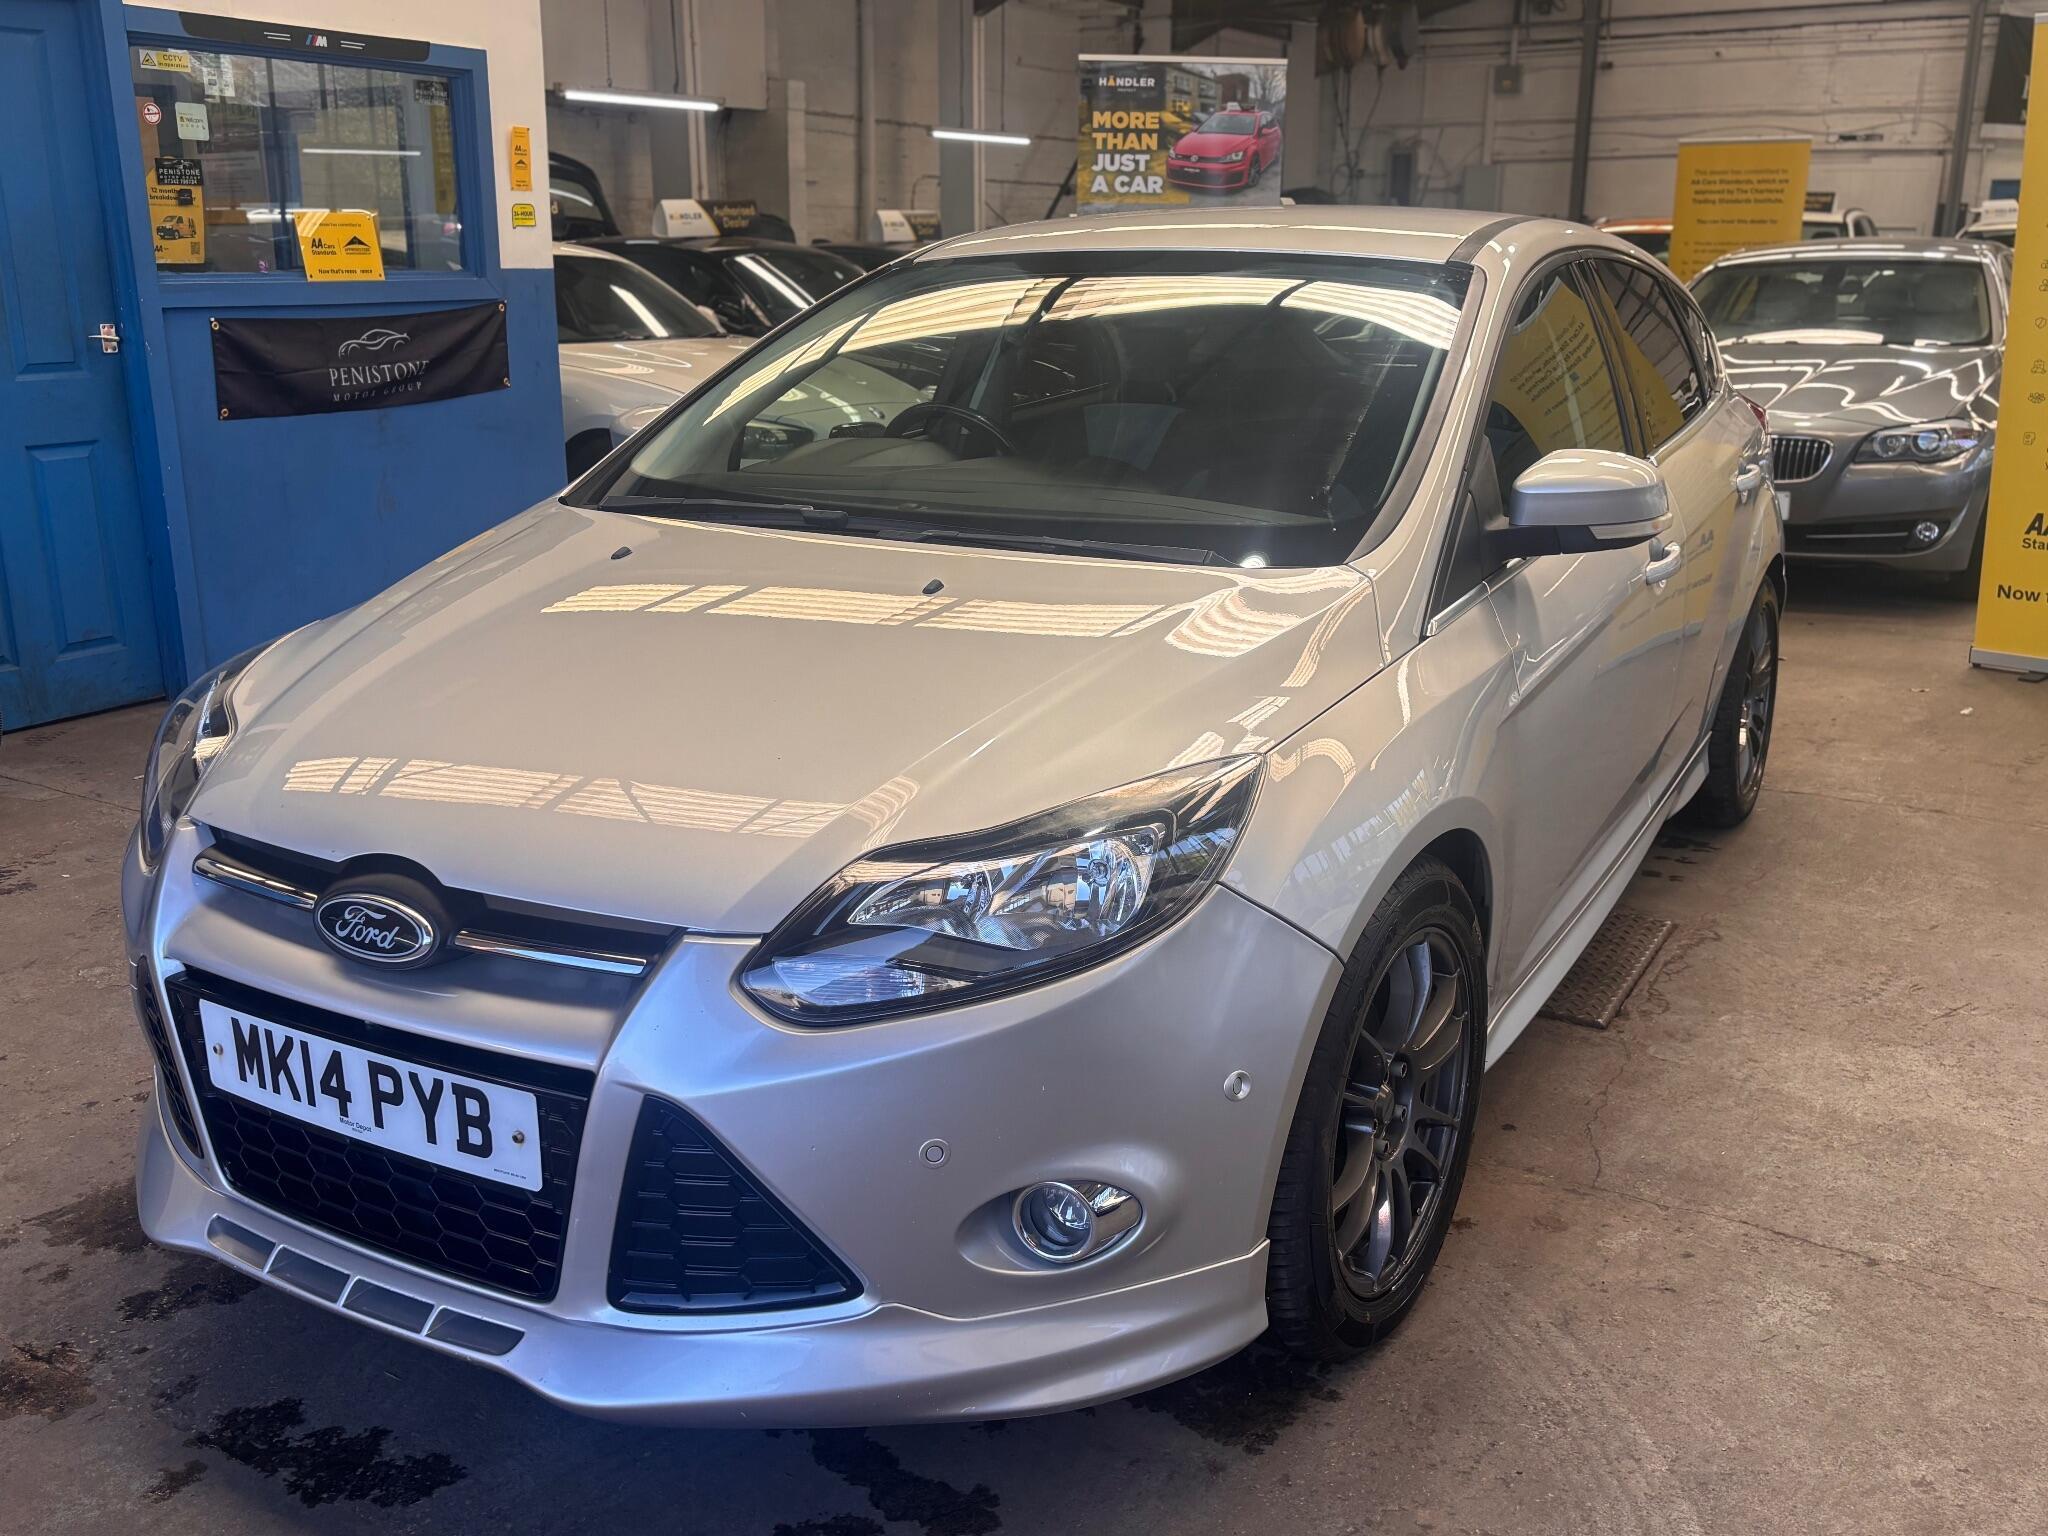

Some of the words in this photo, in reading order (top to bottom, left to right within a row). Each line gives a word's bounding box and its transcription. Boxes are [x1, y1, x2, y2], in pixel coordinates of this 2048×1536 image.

[162, 54, 183, 62] CCTV
[1092, 111, 1160, 129] MORE
[1091, 132, 1158, 150] THAN
[1091, 154, 1150, 172] JUST
[1090, 175, 1109, 193] A
[1114, 175, 1163, 193] CAR
[311, 238, 323, 249] AA
[1997, 584, 2041, 602] Now
[335, 906, 401, 949] Ford
[231, 1017, 353, 1118] MK14
[367, 1060, 493, 1159] PYB
[339, 1117, 355, 1127] Motor
[355, 1122, 372, 1132] Depot
